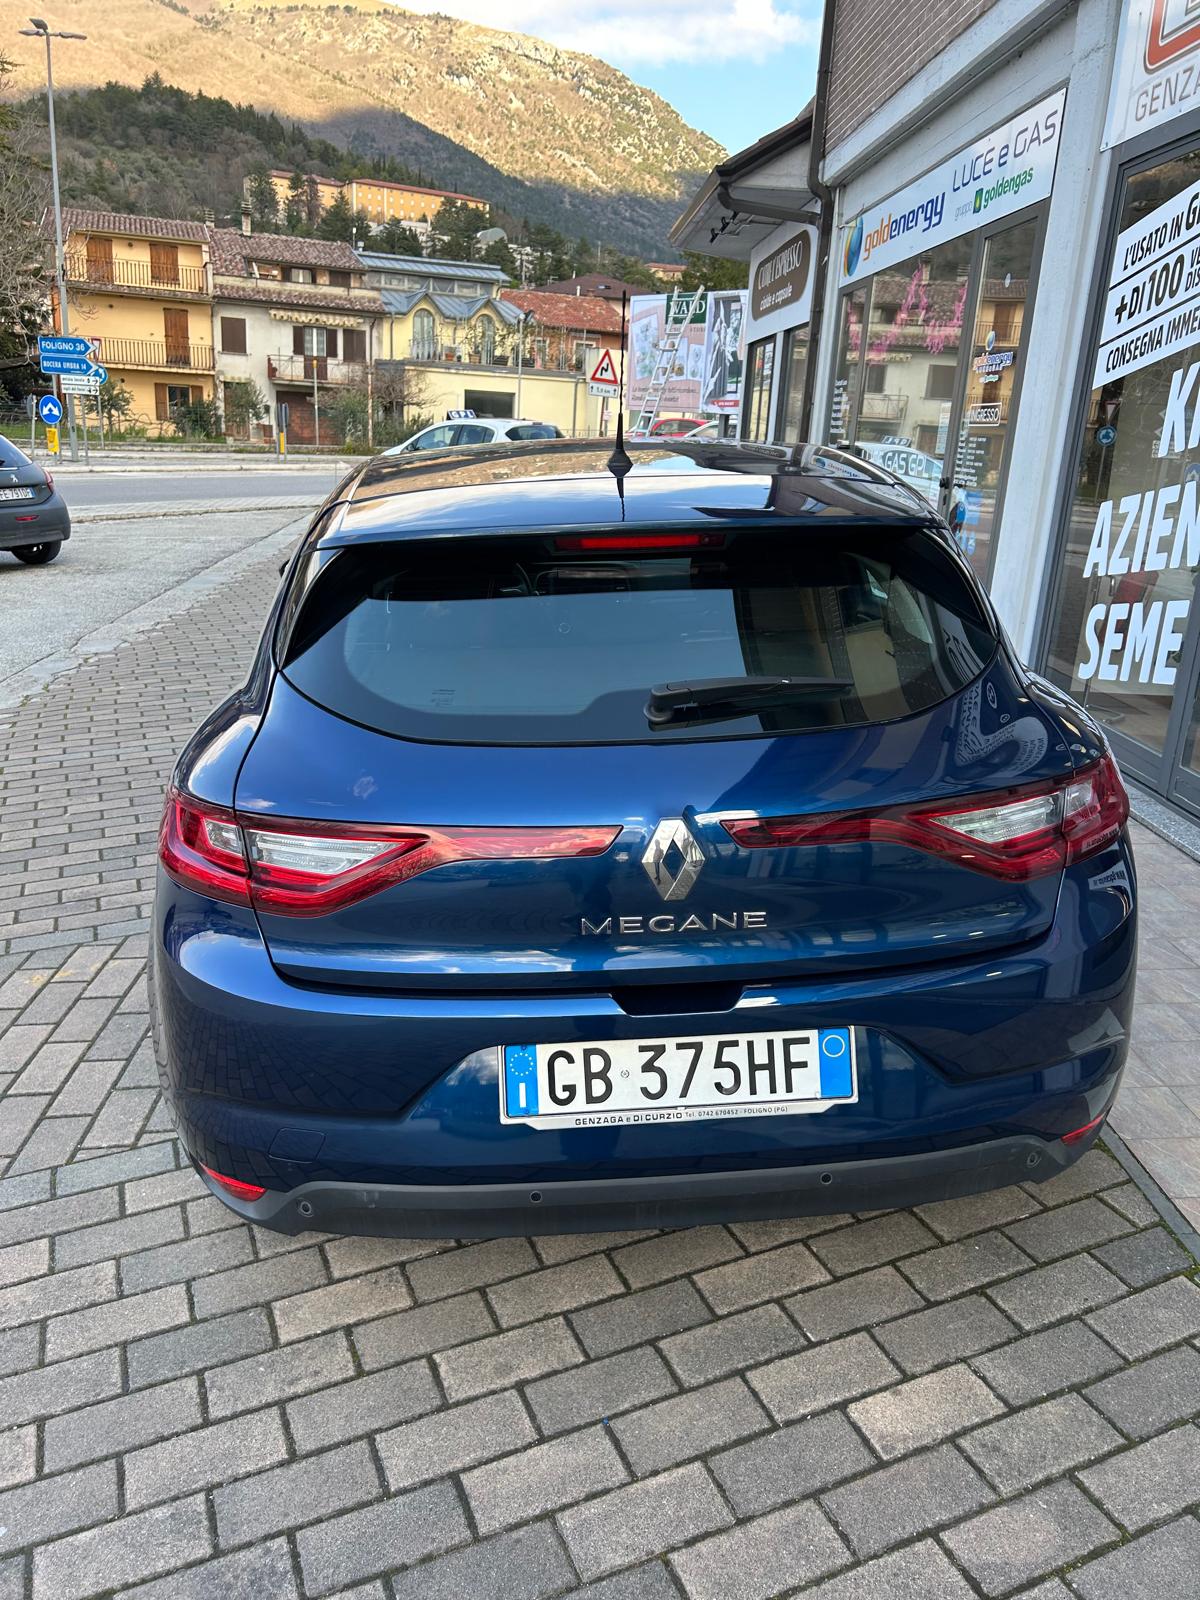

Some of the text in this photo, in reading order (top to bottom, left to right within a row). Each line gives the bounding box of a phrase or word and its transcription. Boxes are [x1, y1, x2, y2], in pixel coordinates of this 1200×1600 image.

[952, 109, 1058, 193] LUCE e GAS
[983, 167, 1034, 210] goldengas
[863, 191, 946, 262] goldenergy
[1123, 191, 1200, 272] L'USATO IN G
[41, 341, 74, 351] FOLIGNO
[1105, 305, 1200, 373] CONSEGNA IMME
[1158, 360, 1200, 458] K
[1082, 480, 1200, 578] AZIEN
[1078, 600, 1190, 685] SEME
[581, 911, 768, 936] MEGANE
[546, 1048, 613, 1107] GB
[637, 1036, 811, 1101] 375HF
[575, 1116, 624, 1126] GENZAGA
[633, 1114, 643, 1122] DI
[645, 1112, 683, 1121] CURZIO
[774, 1106, 788, 1114] (PG)
